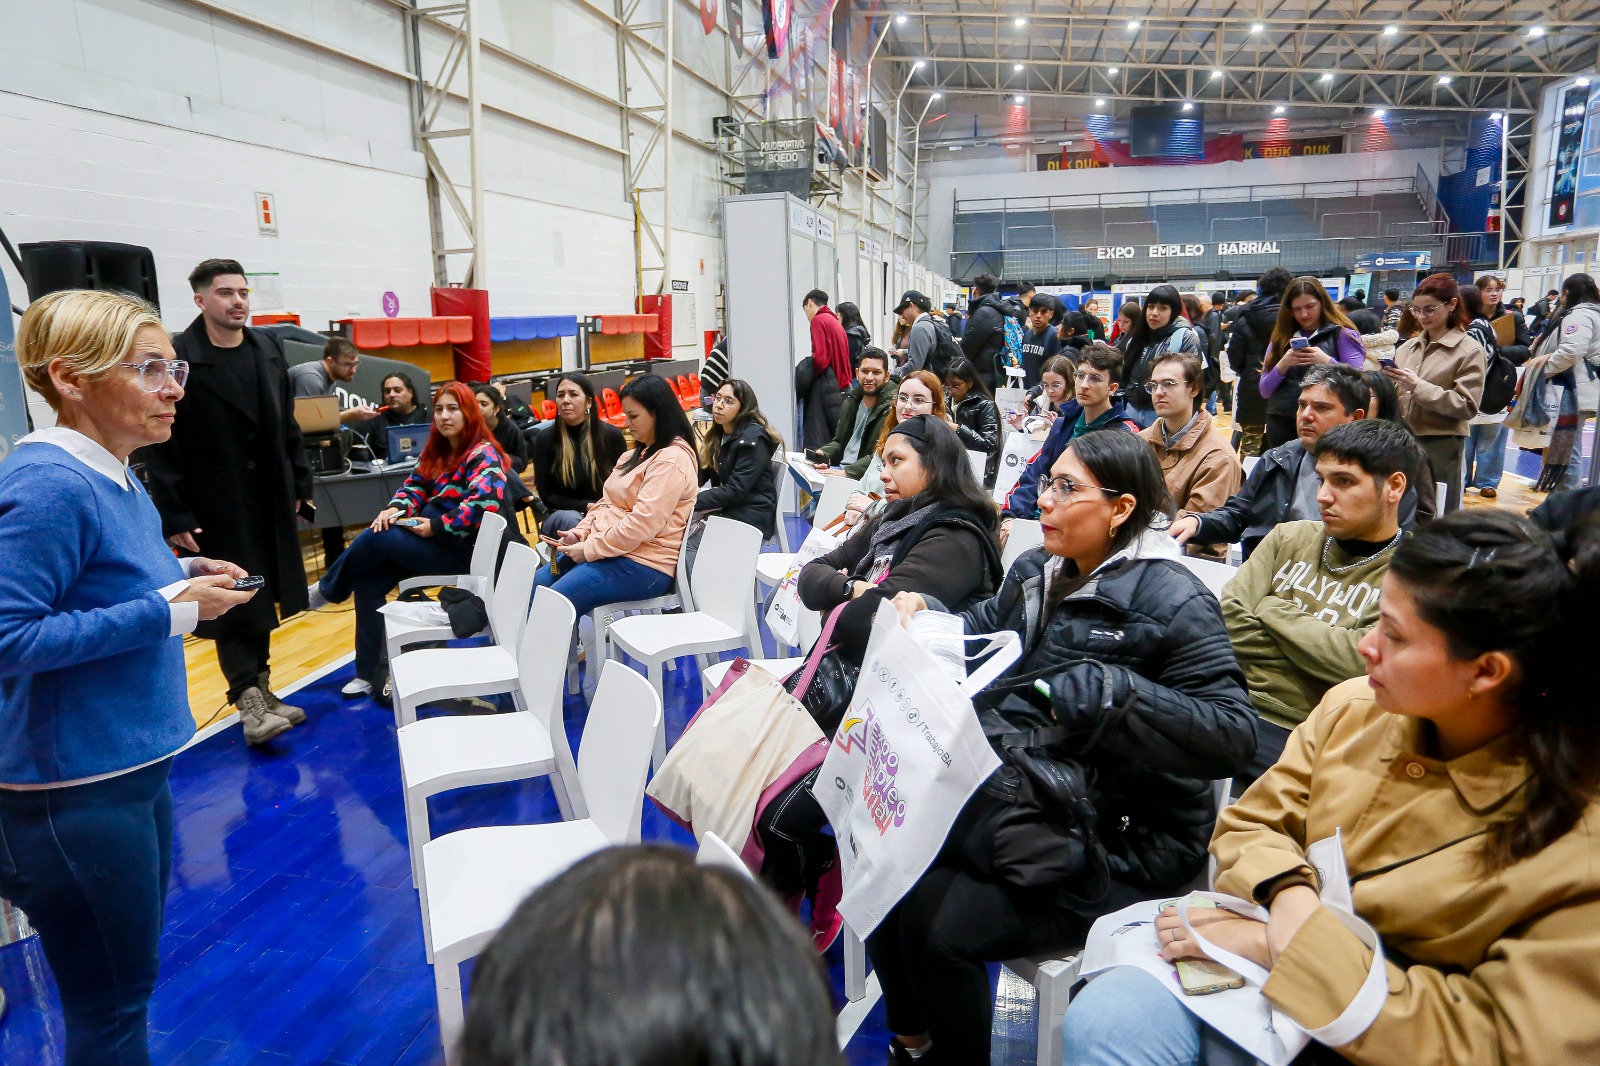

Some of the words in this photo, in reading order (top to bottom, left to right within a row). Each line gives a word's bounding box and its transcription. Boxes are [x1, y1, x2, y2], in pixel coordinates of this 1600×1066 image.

[768, 152, 799, 164] BOEDO
[1097, 246, 1135, 260] EXPO
[1149, 244, 1205, 258] EMPLEO
[1218, 241, 1281, 256] BARRIAL
[1022, 343, 1045, 356] OSTON
